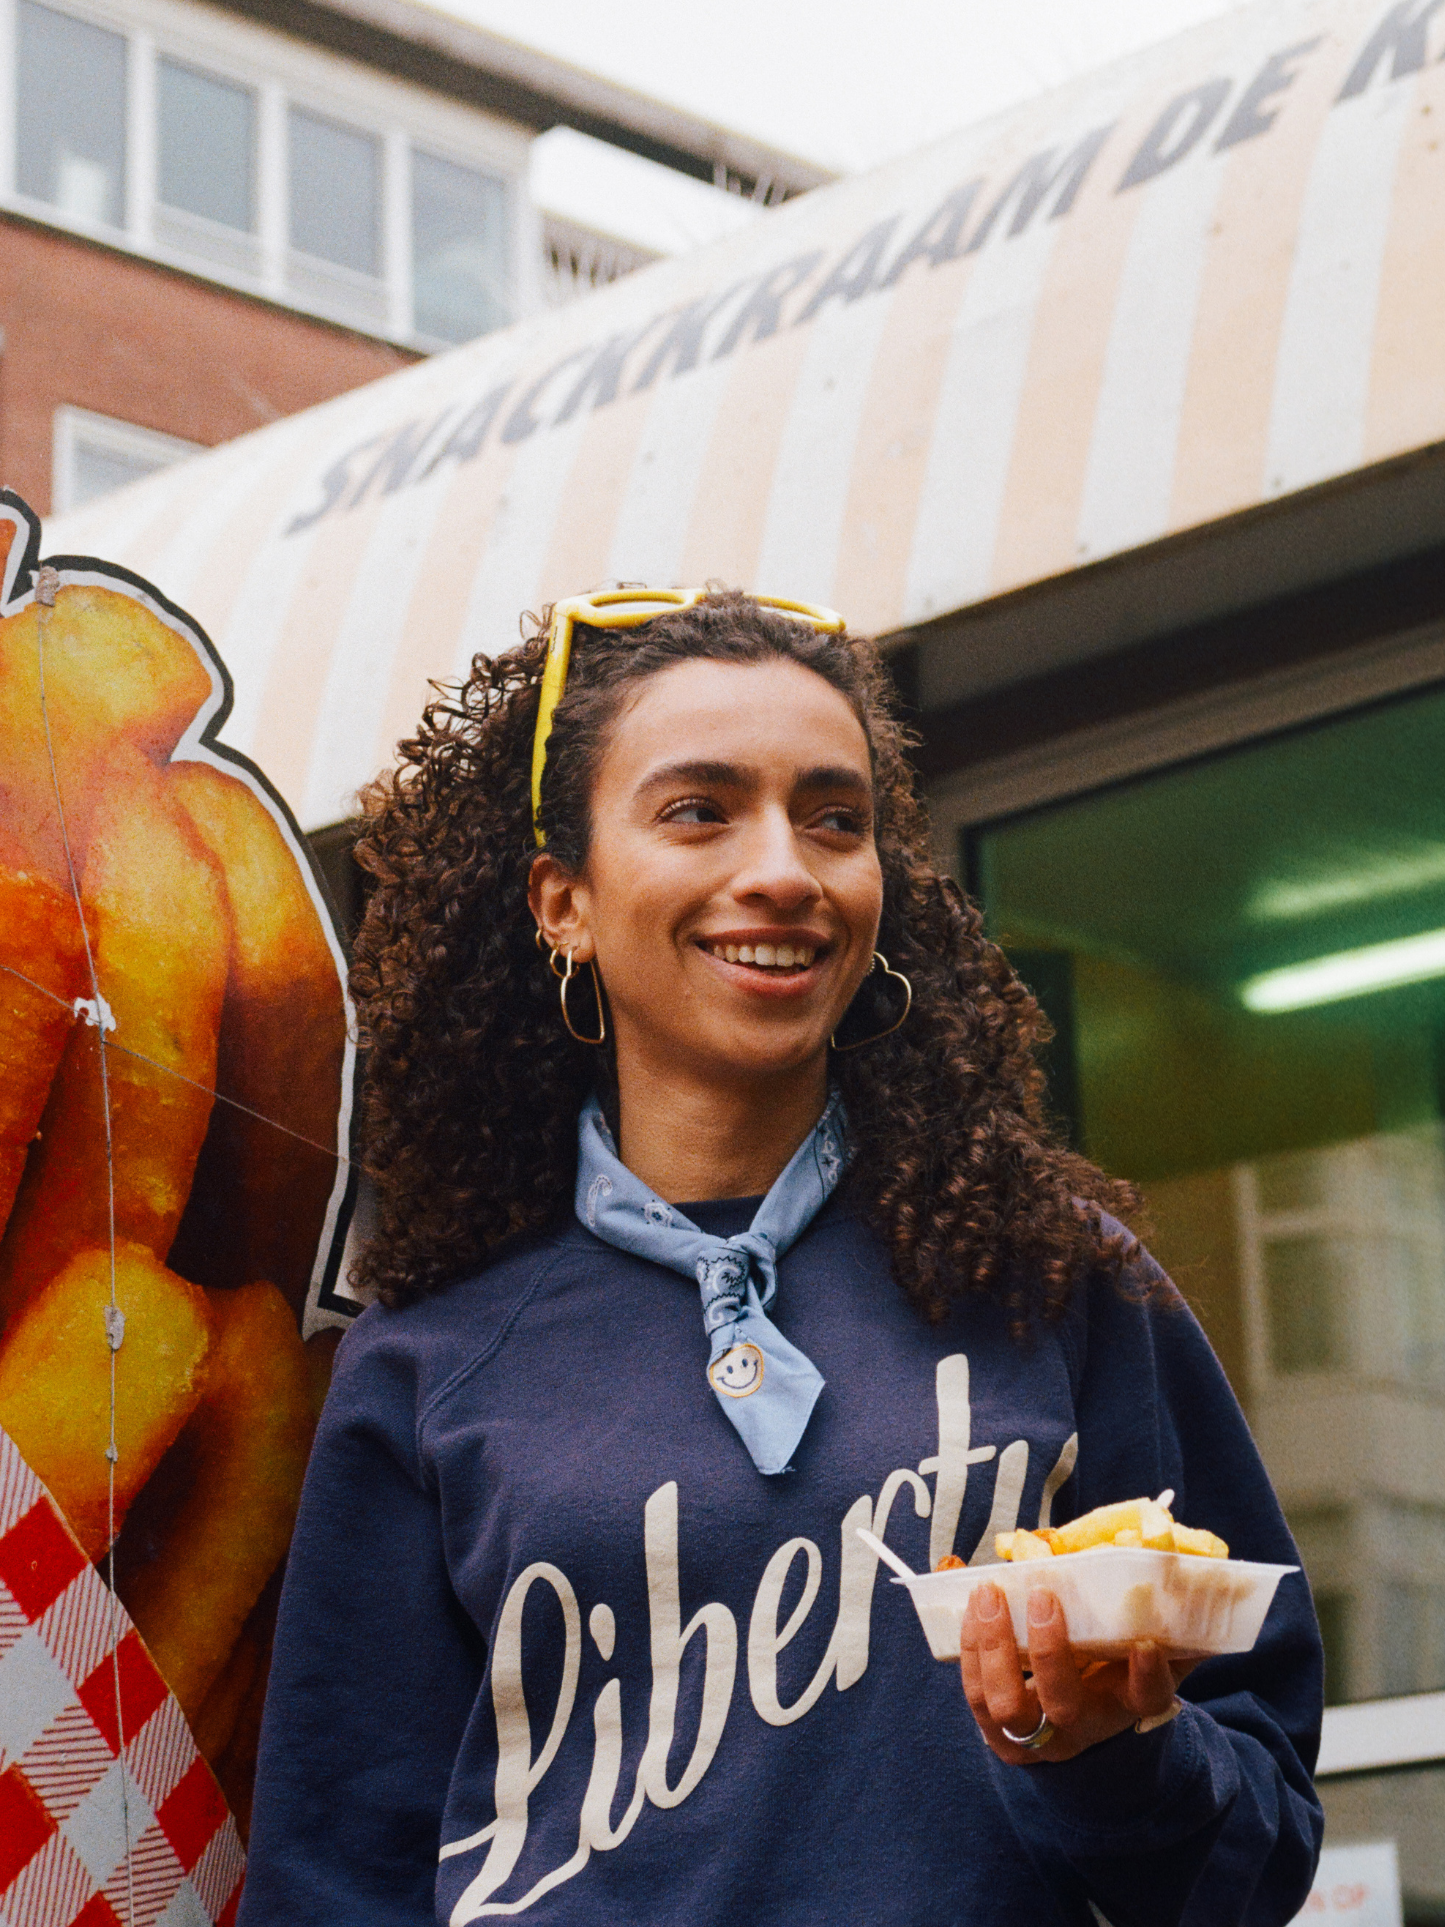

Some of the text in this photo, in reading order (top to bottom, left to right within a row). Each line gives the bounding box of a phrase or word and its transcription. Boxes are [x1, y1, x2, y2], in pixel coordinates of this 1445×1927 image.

[284, 0, 1445, 536] SNACKKRAAM DE K
